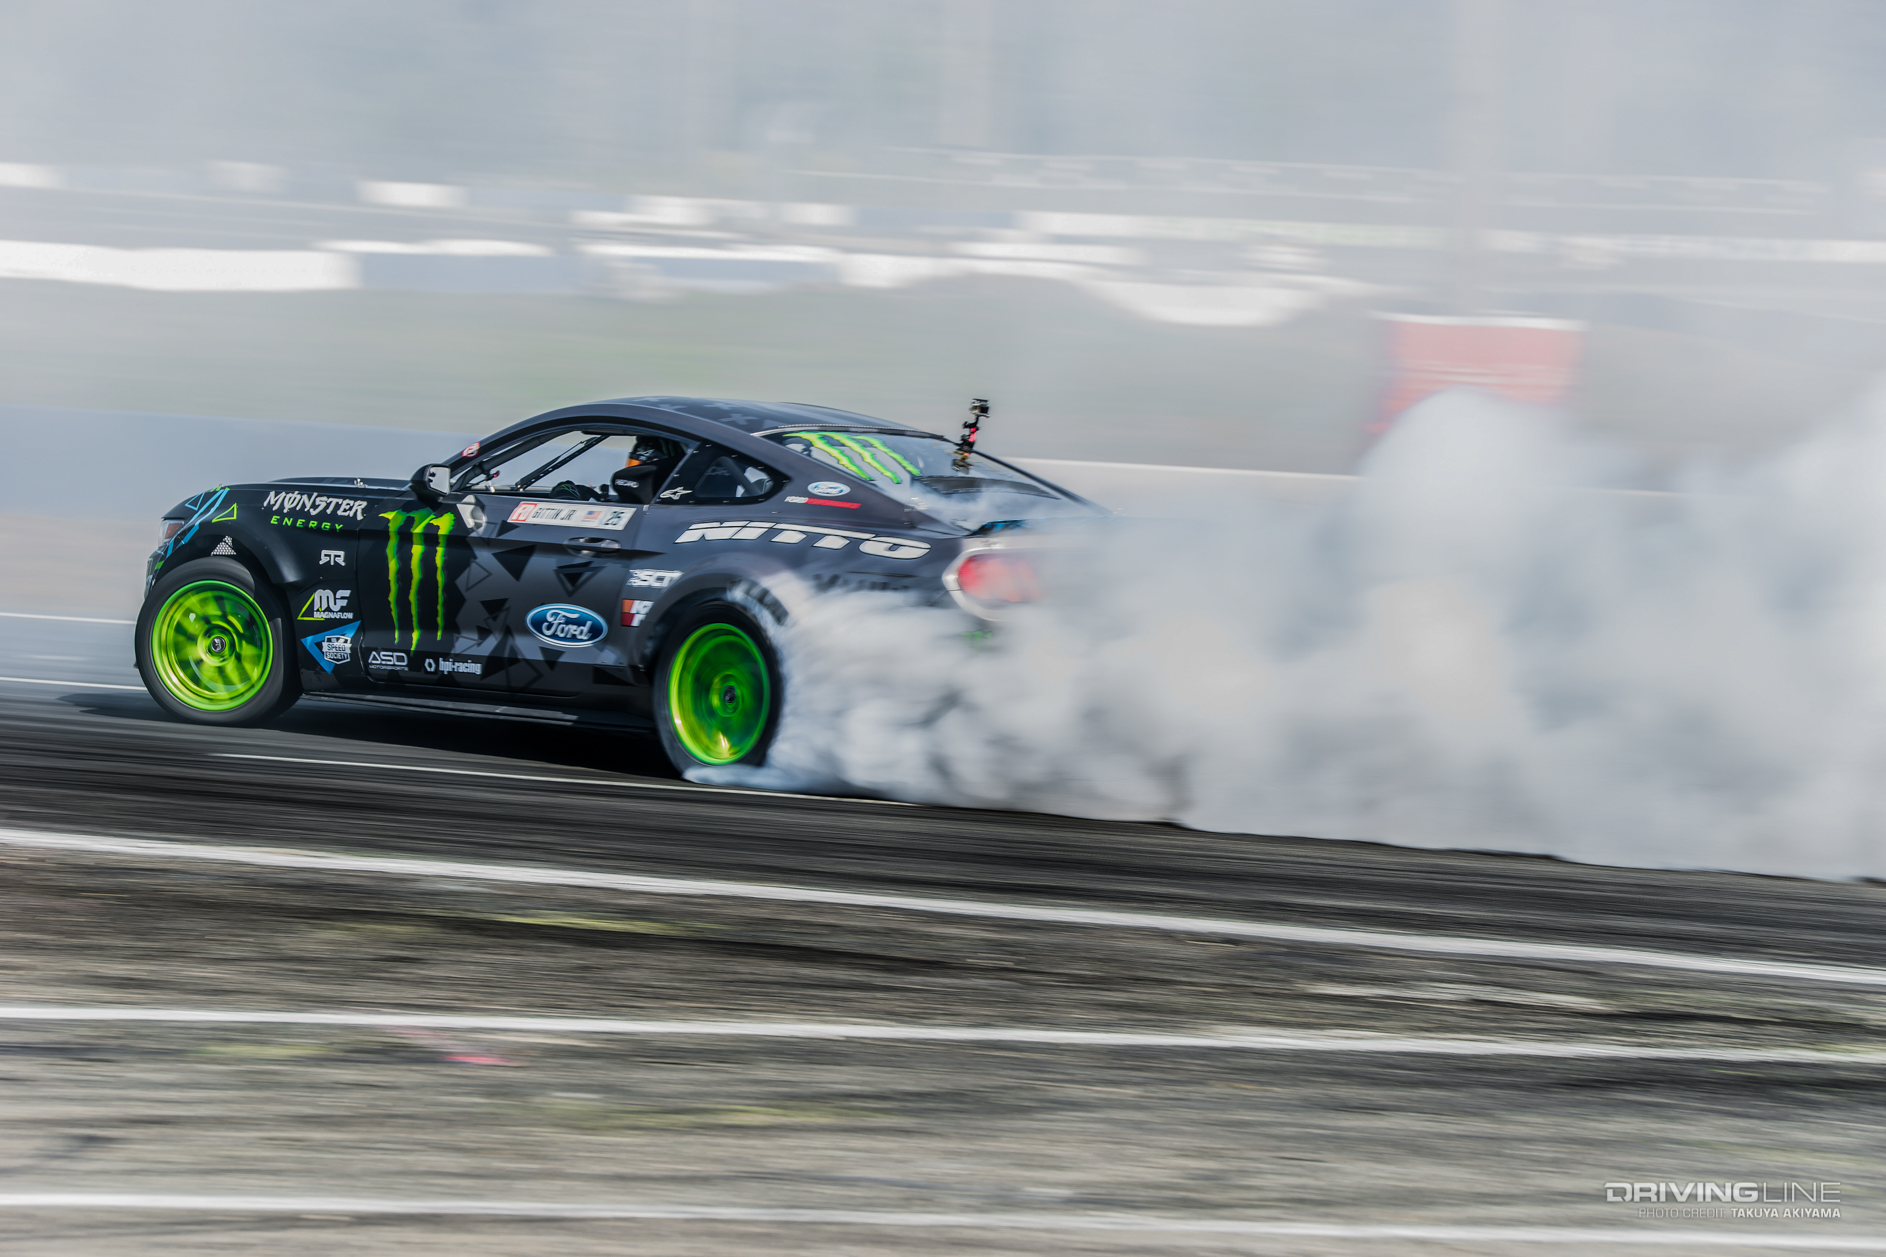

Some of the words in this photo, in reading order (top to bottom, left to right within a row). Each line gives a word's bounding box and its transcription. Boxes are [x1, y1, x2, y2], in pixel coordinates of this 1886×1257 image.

[270, 515, 343, 532] ENERGY
[604, 510, 624, 526] 25
[673, 520, 932, 560] NITTO
[314, 611, 354, 619] MAGNAFLOW
[541, 609, 593, 640] Ford
[326, 643, 346, 652] SPEED
[326, 652, 348, 660] SOCIETY
[368, 651, 408, 665] ASD
[438, 657, 482, 675] hpi-racing
